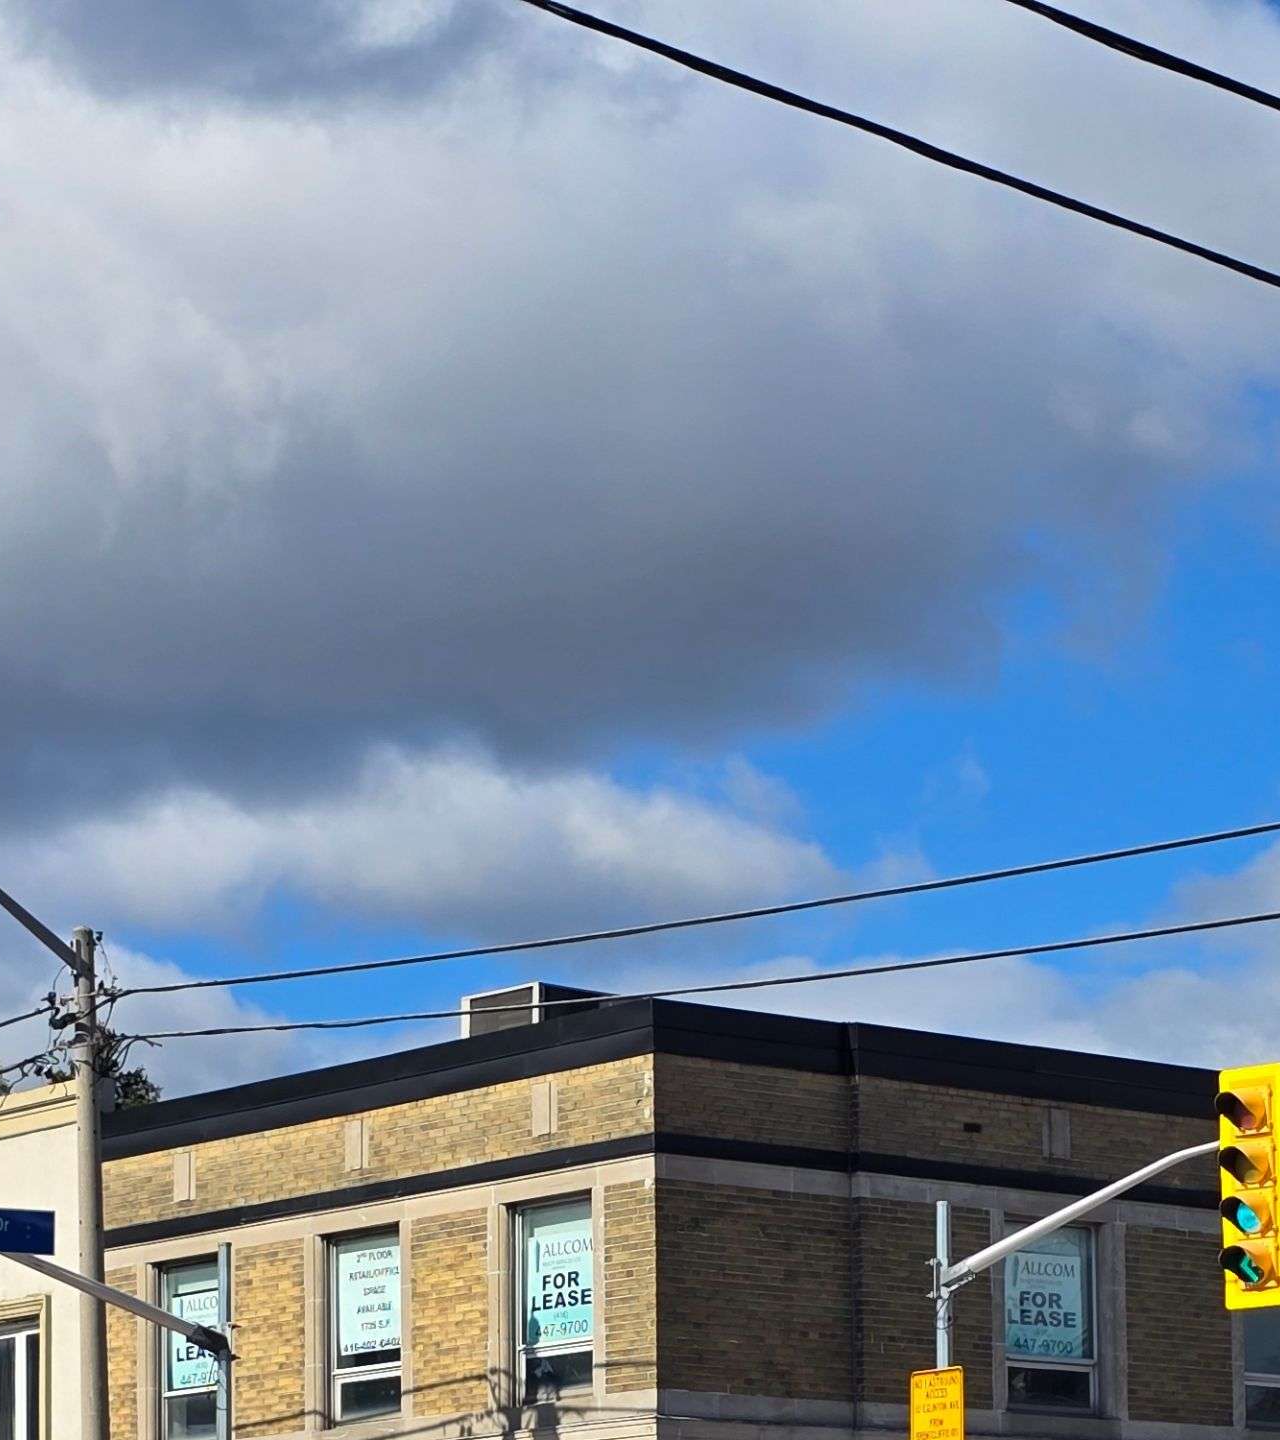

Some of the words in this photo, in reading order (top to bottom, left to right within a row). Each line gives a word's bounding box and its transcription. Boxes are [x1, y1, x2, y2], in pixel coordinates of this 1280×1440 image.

[542, 1238, 593, 1258] ALLCOM
[1021, 1261, 1076, 1279] ALLCOM
[542, 1270, 580, 1291] FOR
[185, 1295, 219, 1313] ALLCO
[531, 1288, 593, 1312] LEASE
[1019, 1290, 1063, 1309] FOR
[1007, 1308, 1077, 1328] LEASE
[537, 1319, 589, 1337] 447-9700
[176, 1345, 217, 1363] LEA
[1013, 1337, 1074, 1354] 447-9700
